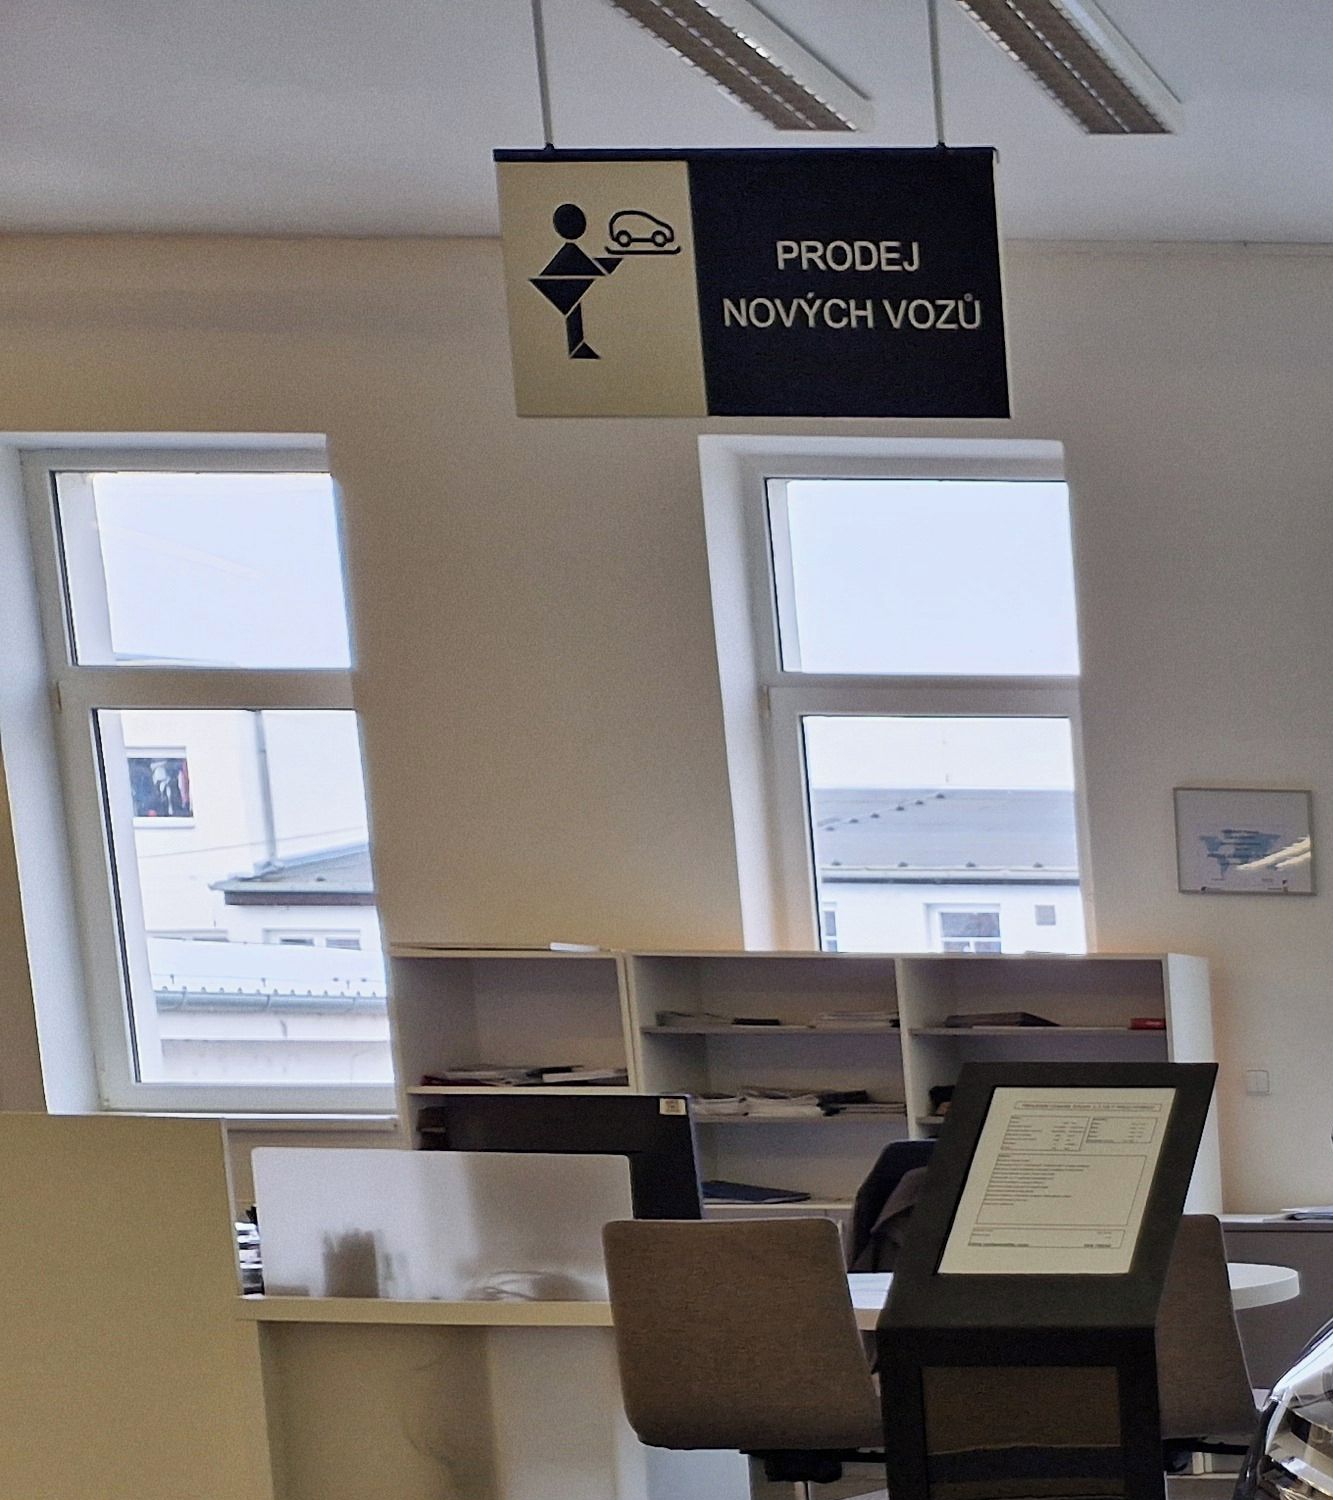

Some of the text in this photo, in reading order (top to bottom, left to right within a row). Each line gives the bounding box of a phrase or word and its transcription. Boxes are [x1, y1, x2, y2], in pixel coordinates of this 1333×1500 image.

[777, 240, 920, 272] PRODEJ
[723, 292, 981, 330] NOVÝCH VOZŮ
